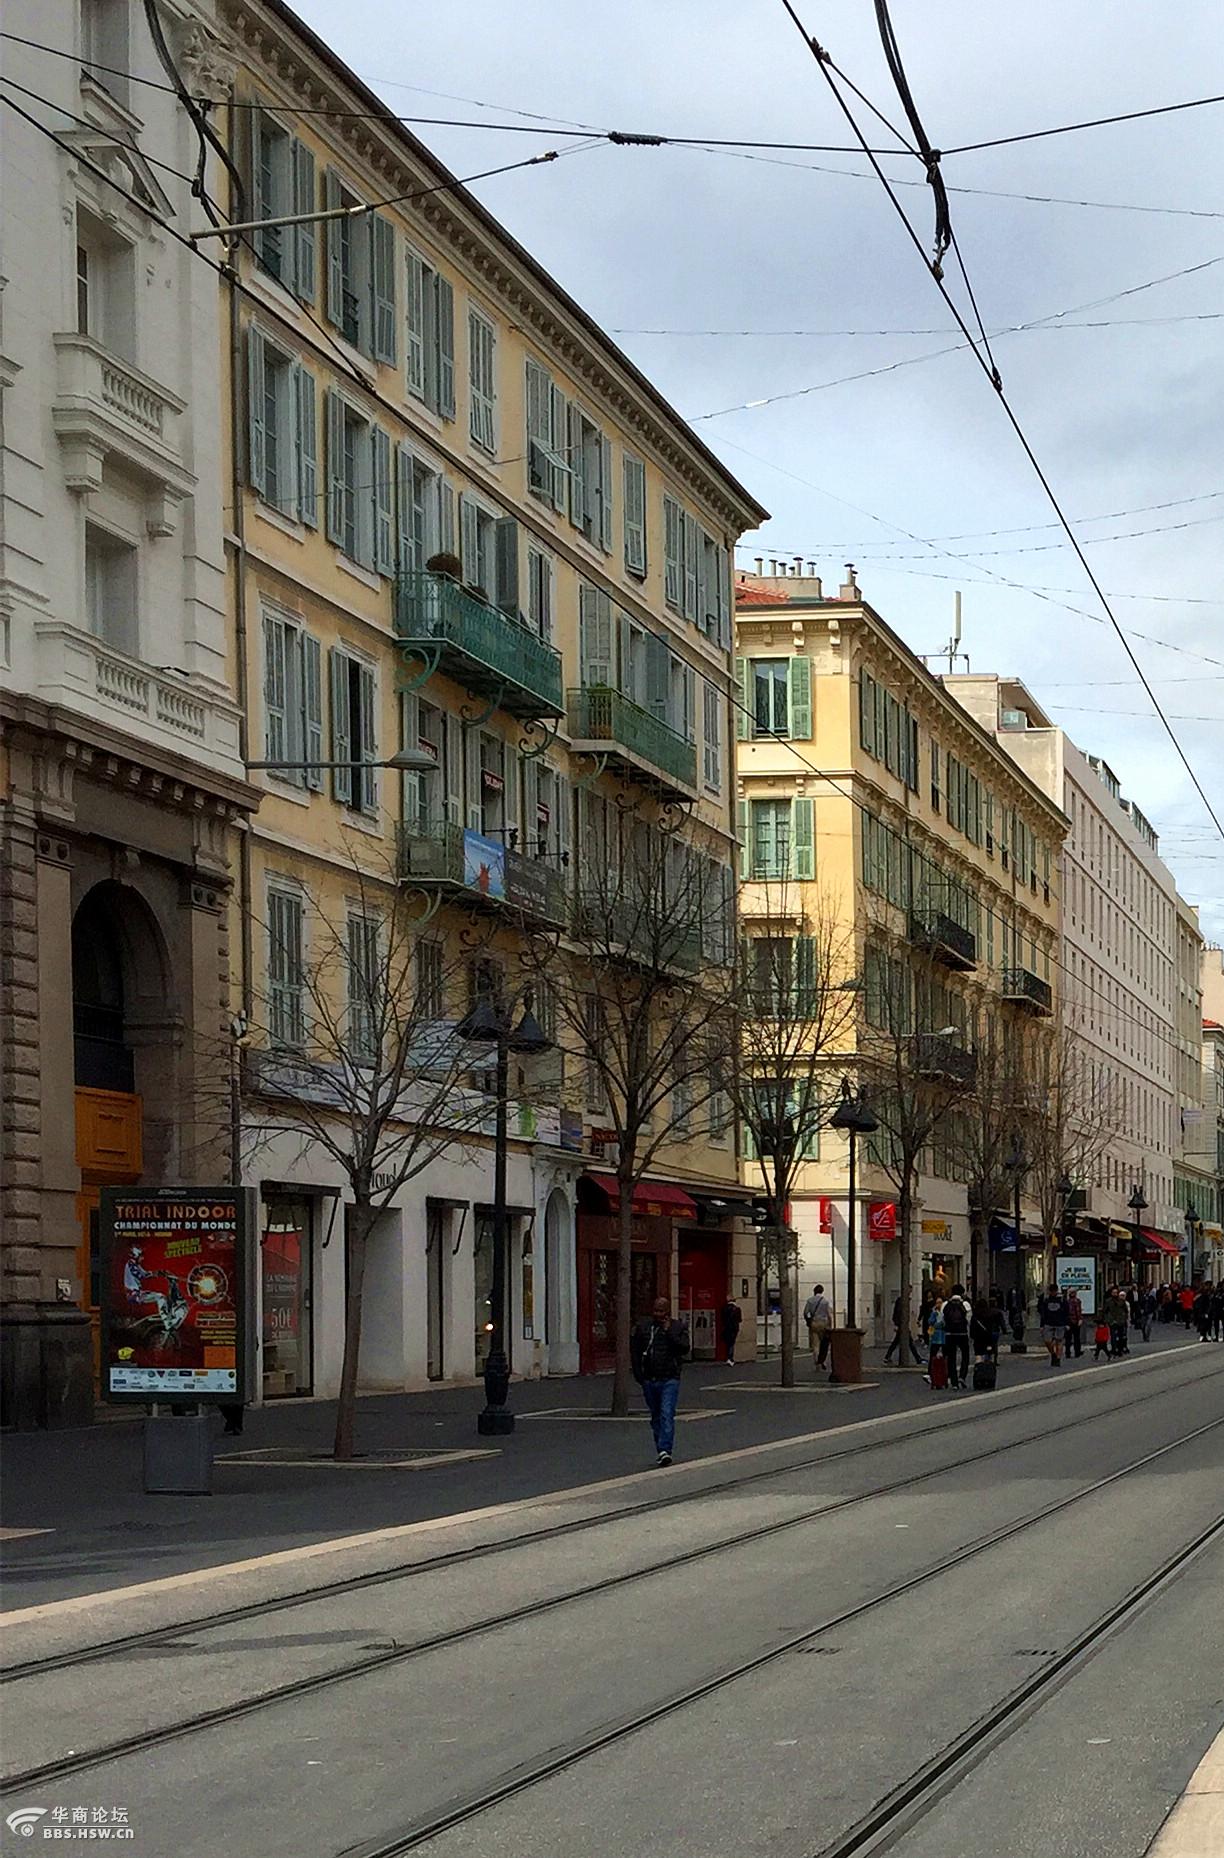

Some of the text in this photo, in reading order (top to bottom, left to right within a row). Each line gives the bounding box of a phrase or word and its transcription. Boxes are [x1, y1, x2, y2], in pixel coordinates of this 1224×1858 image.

[115, 1205, 237, 1219] TRIAL INDOOR
[113, 1221, 237, 1230] CHAMPIONNAT DU MONDE
